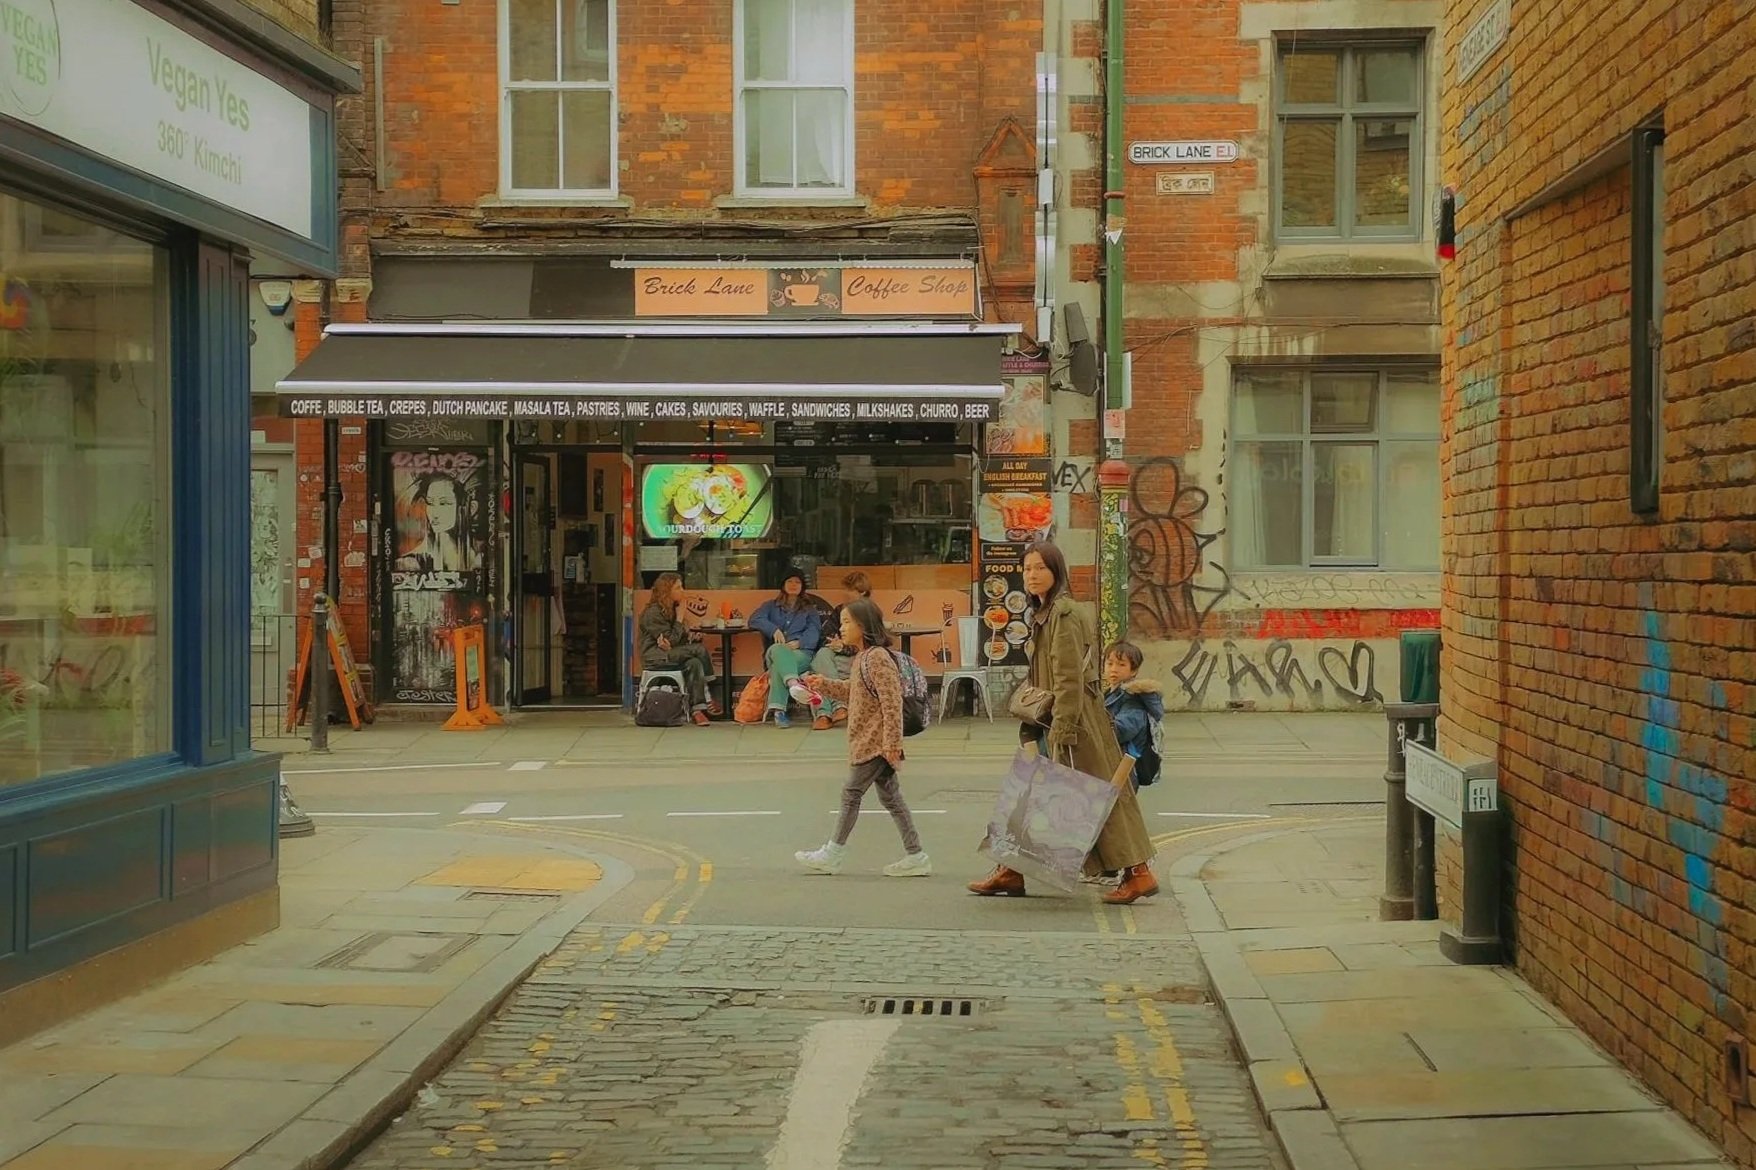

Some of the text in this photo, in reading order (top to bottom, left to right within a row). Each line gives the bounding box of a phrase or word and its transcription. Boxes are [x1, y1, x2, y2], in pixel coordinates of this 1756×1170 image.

[13, 46, 47, 86] YES
[146, 37, 250, 132] Vegan Yes
[194, 136, 242, 184] Kimchi
[1133, 146, 1170, 158] BRICK
[1176, 146, 1211, 158] LANE
[644, 275, 969, 299] Brick Lane Coffee Shop
[328, 400, 364, 415] BUBBLE
[432, 401, 464, 415] DUTCH
[514, 401, 551, 416] MASALA
[965, 403, 990, 418] BEER
[984, 472, 1046, 480] ENGLISH BREAKFAST
[985, 564, 1014, 573] FOOD
